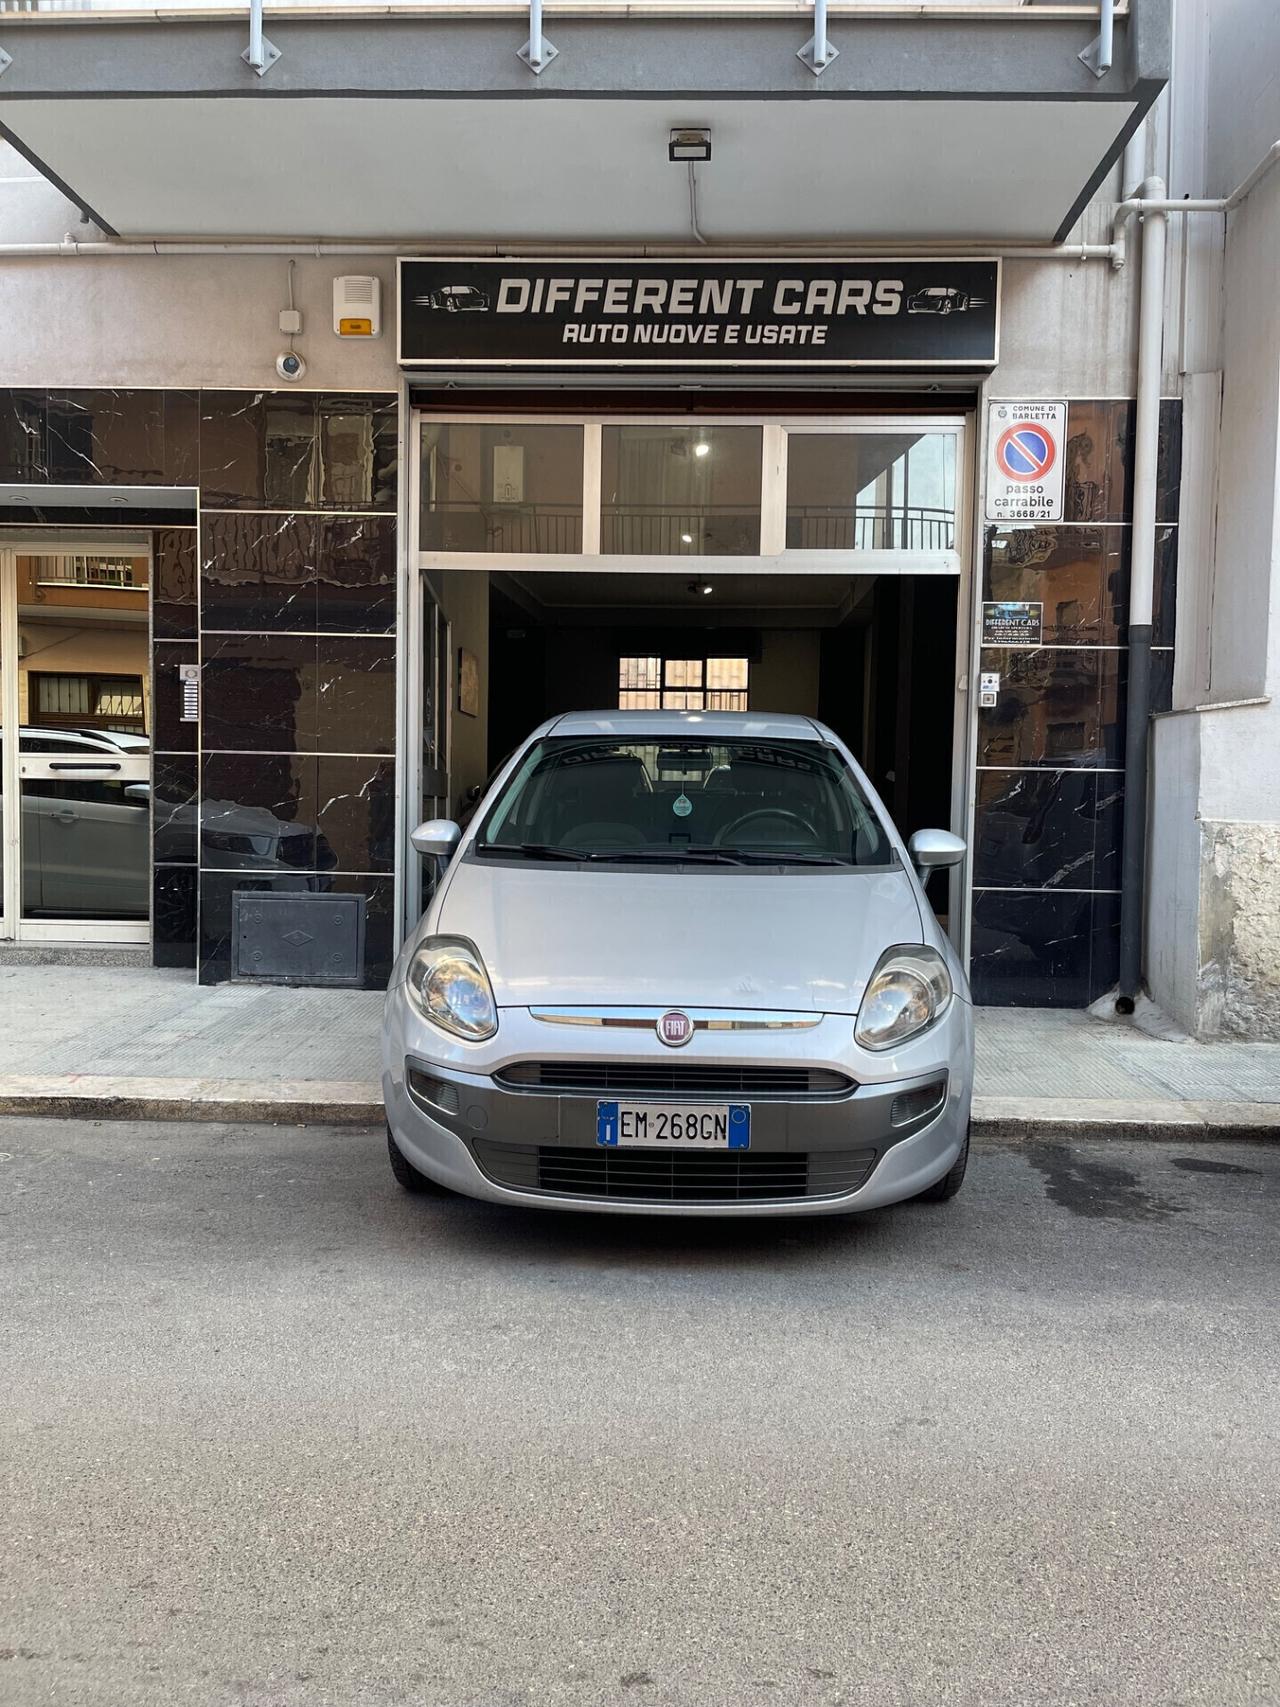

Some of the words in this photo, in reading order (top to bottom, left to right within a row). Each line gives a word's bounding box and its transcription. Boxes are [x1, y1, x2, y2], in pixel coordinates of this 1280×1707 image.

[496, 278, 765, 314] DIFFERENT
[773, 279, 904, 315] CARS
[562, 323, 627, 343] AUTO
[632, 323, 719, 344] NUOVE
[724, 324, 739, 343] E
[745, 324, 828, 345] USATE
[1012, 412, 1057, 420] BARLETTA
[1006, 485, 1044, 495] passo
[994, 496, 1054, 507] carrabile
[1009, 510, 1051, 518] 3668/21
[665, 1020, 686, 1036] FIAT
[620, 1111, 648, 1138] EM
[655, 1112, 727, 1140] 268GN
